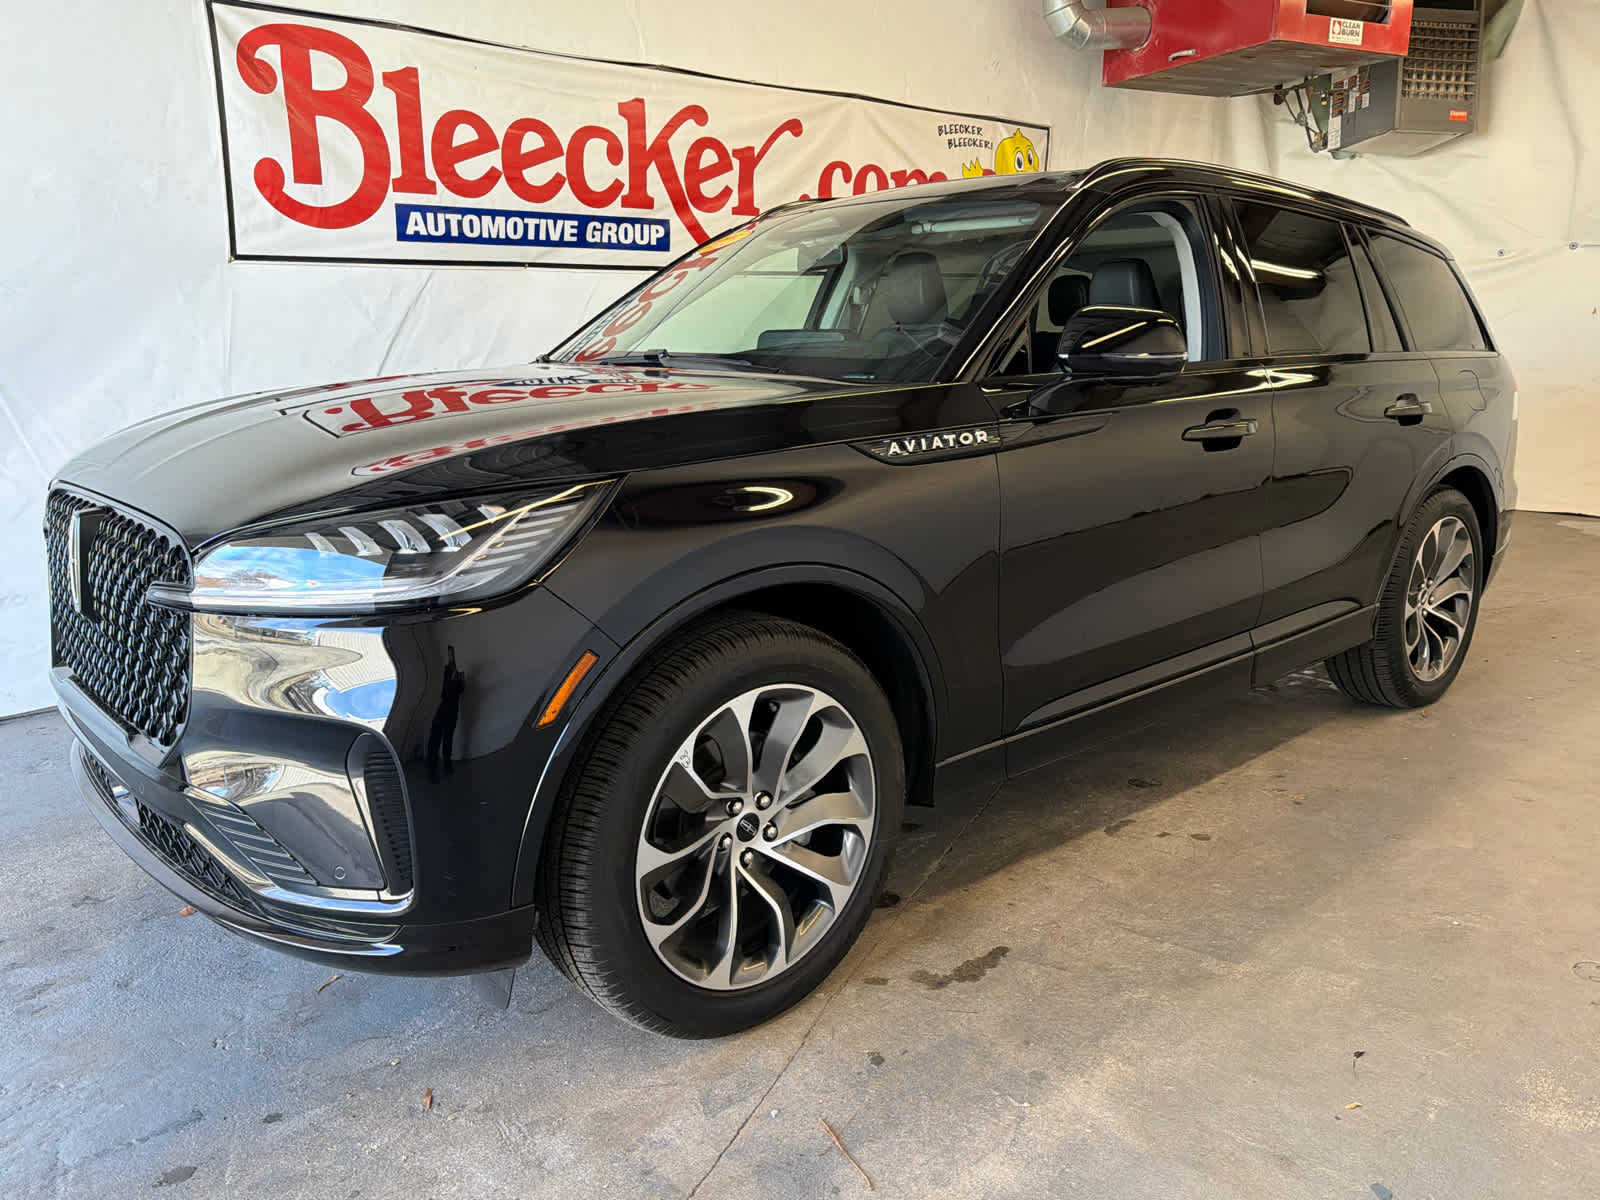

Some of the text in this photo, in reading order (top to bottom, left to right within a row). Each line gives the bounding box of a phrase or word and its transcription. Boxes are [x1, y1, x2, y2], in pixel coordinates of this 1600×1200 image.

[1341, 29, 1361, 37] BURN
[236, 23, 803, 246] Bleecker
[937, 123, 984, 136] BLEECKER
[947, 137, 994, 150] BLEECKER!
[405, 211, 666, 247] AUTOMOTIVE GROUP
[887, 429, 989, 456] AVIATOR
